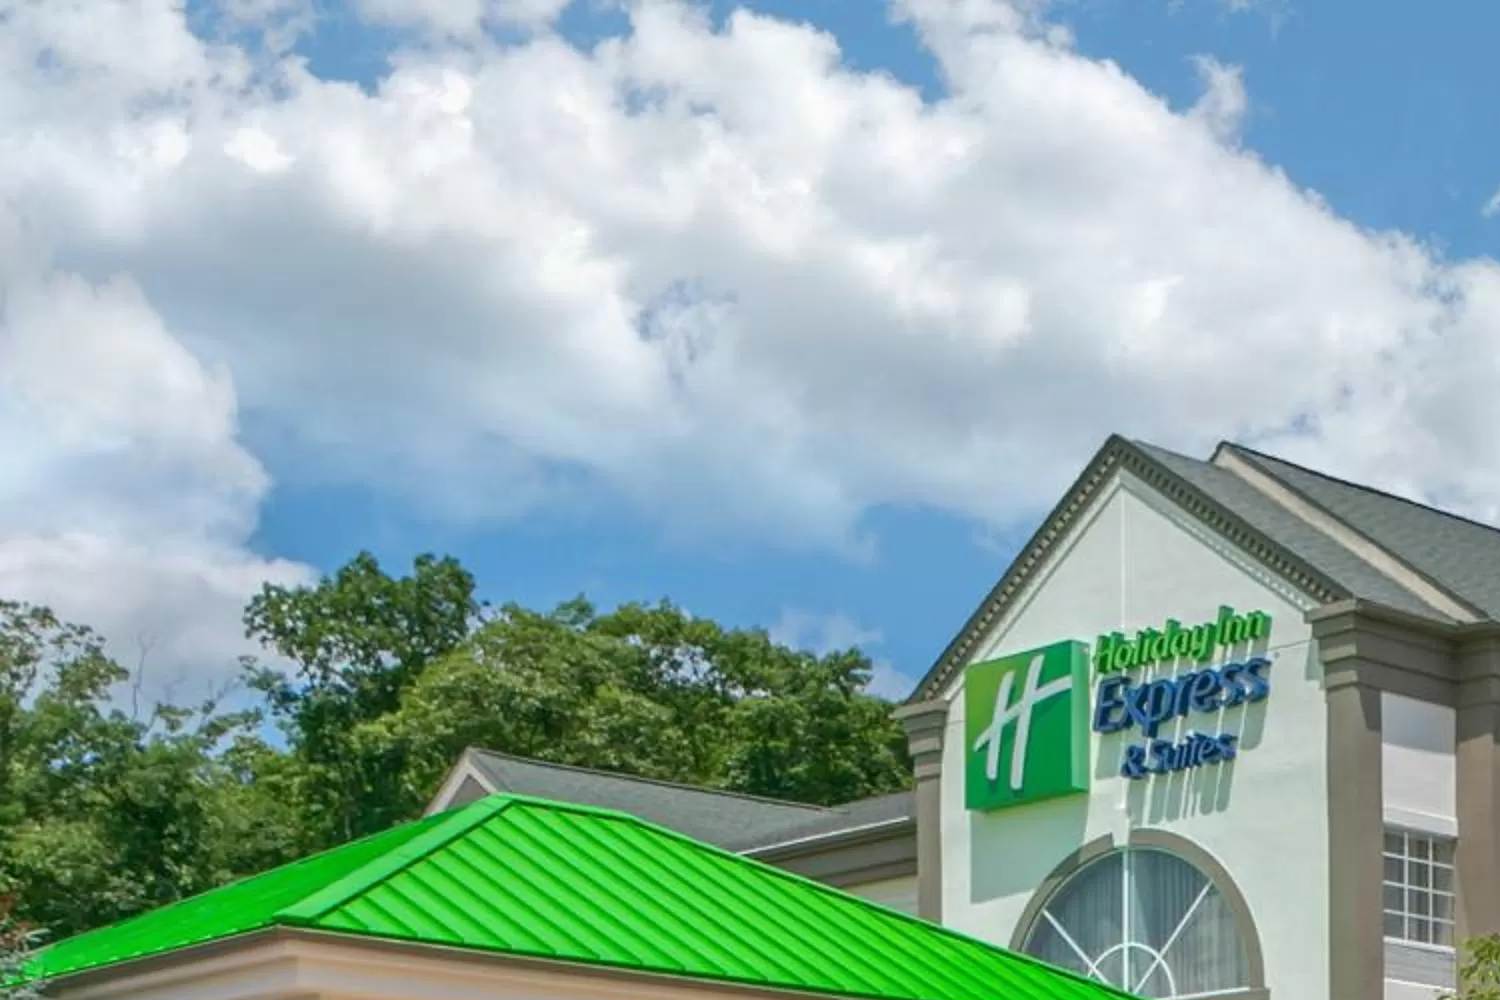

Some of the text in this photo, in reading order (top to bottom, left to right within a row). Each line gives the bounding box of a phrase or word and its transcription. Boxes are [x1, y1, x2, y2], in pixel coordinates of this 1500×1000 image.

[1094, 605, 1272, 674] Holiday Inn
[1093, 657, 1271, 737] Express
[1149, 733, 1237, 774] Suites
